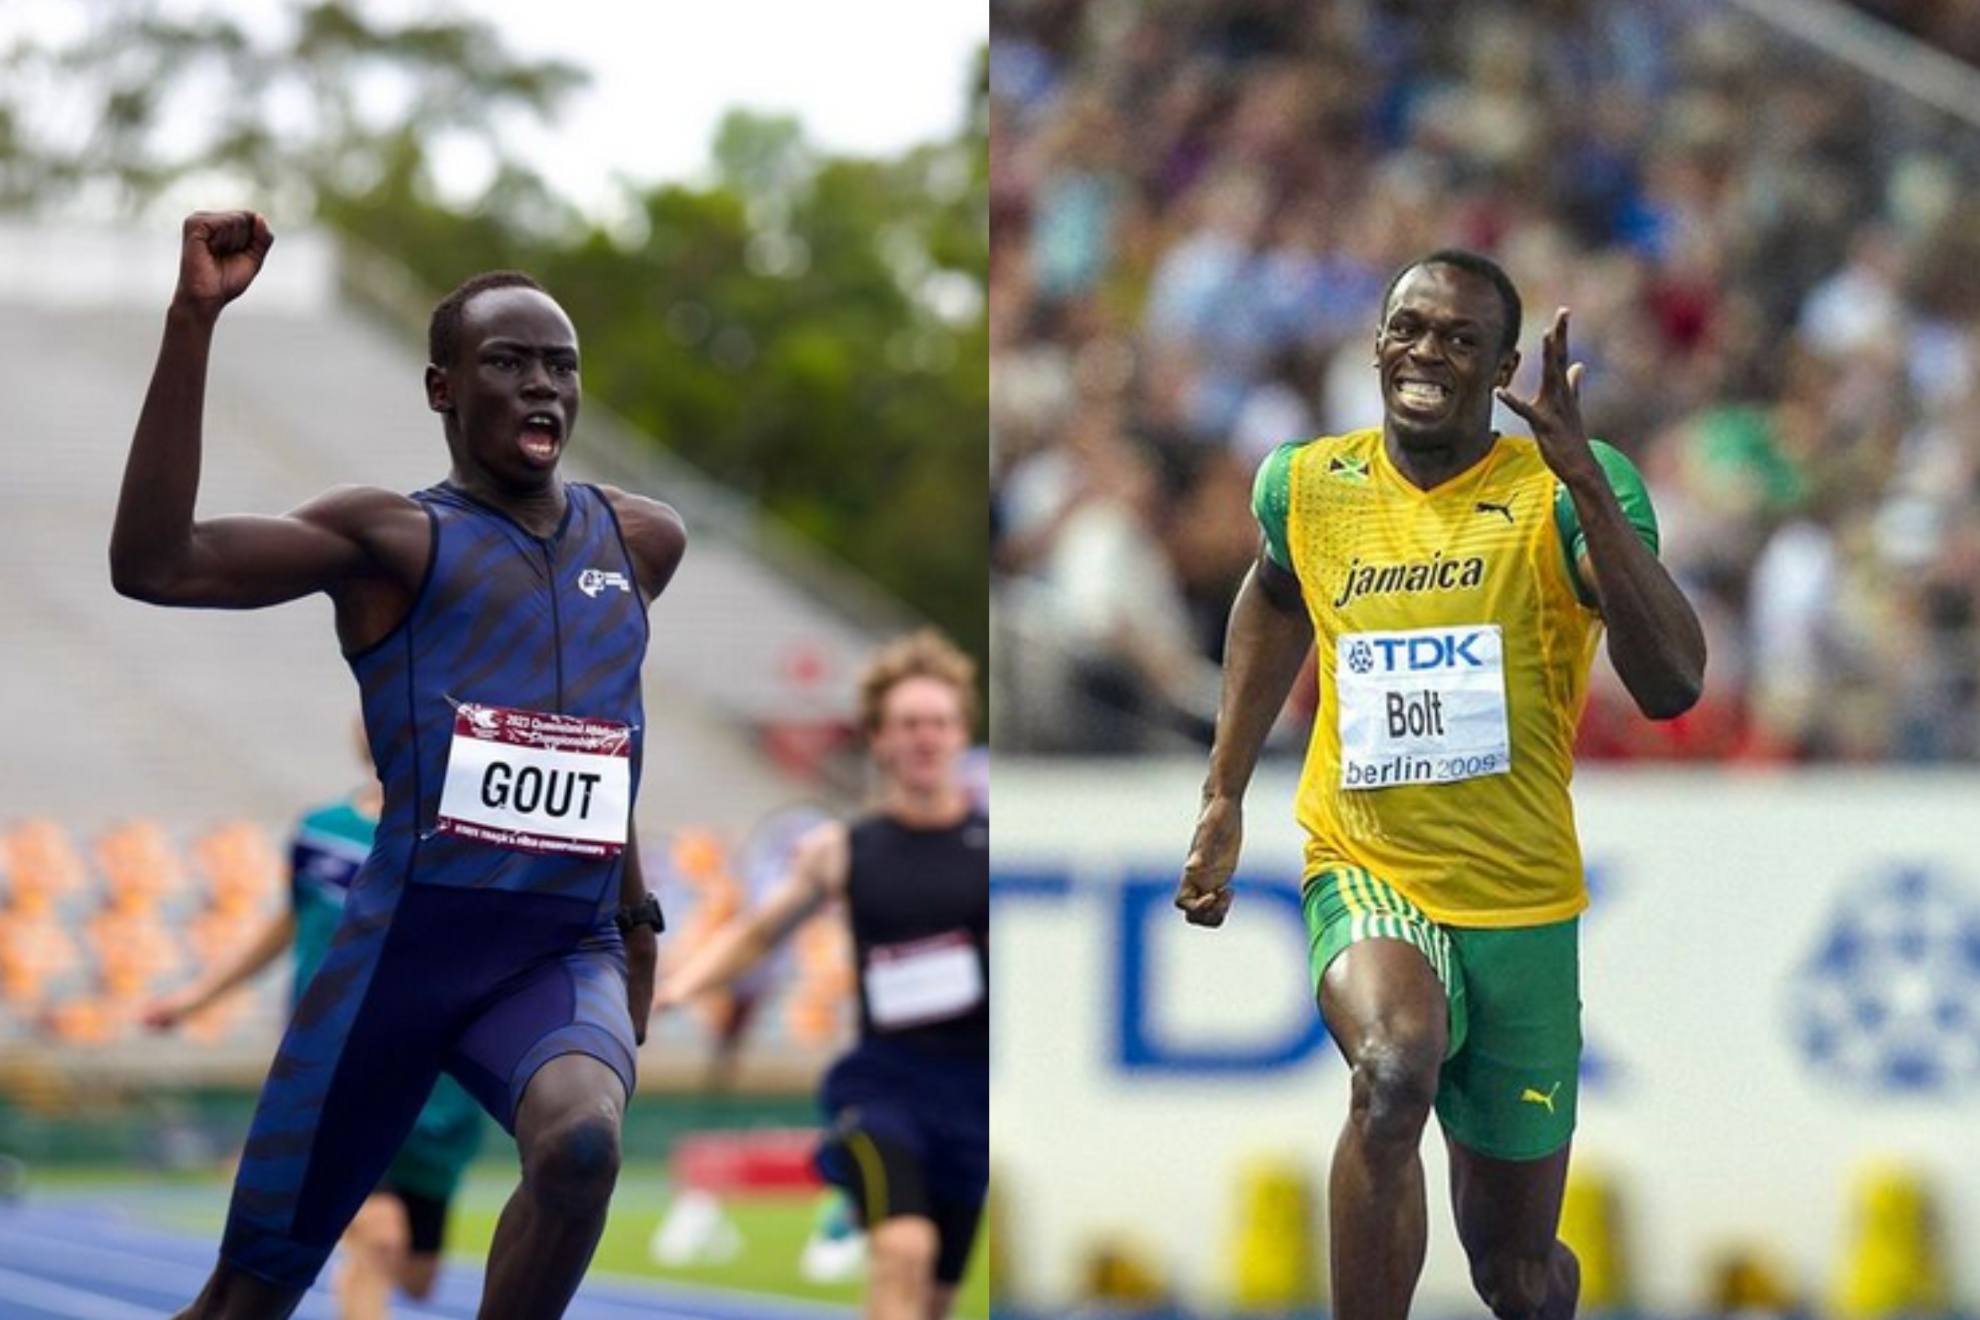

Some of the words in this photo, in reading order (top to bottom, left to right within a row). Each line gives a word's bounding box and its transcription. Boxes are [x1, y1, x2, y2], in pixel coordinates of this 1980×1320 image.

[1334, 550, 1484, 608] jamaica
[1374, 632, 1483, 671] TDK
[1386, 689, 1444, 738] Bolt
[481, 761, 602, 820] GOUT
[1346, 756, 1432, 785] berlin
[1436, 754, 1496, 779] 2009
